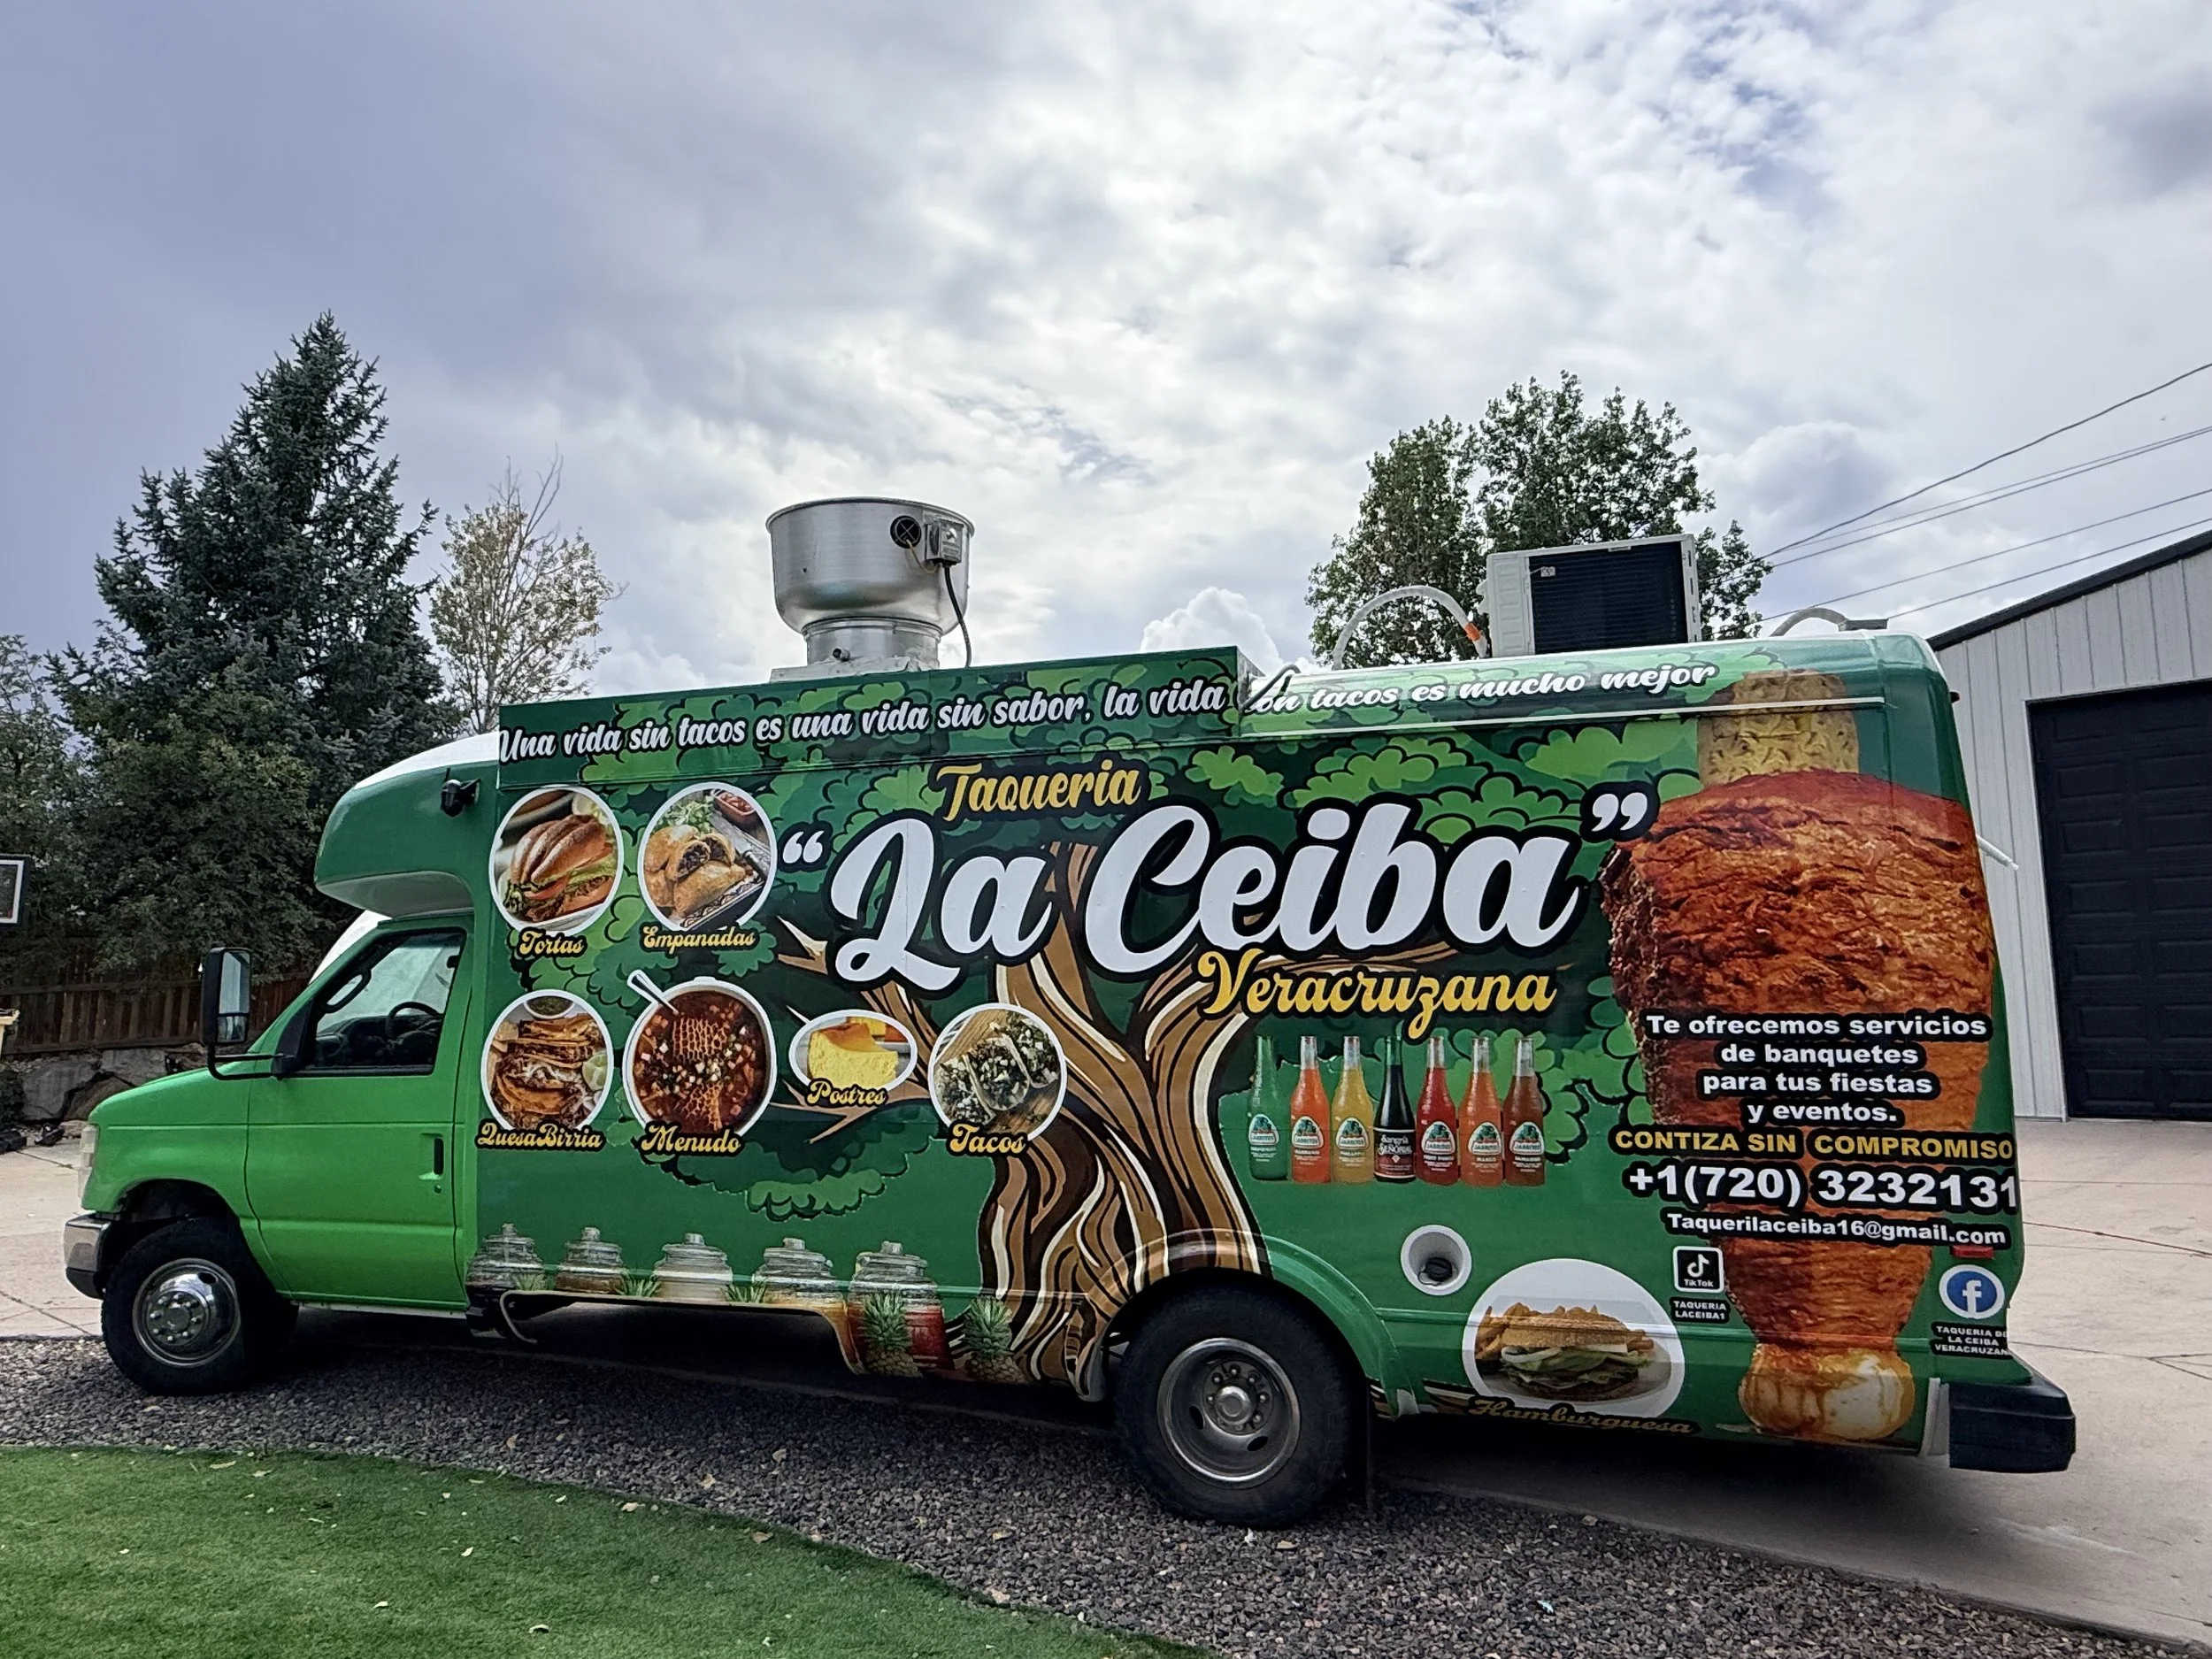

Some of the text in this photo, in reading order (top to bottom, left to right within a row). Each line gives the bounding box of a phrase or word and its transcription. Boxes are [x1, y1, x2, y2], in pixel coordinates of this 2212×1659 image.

[499, 664, 1716, 762] Una vida sin tacos es una vida sin sabor, la vida on tacos es mucho mejor
[936, 759, 1143, 822] Taqueria
[519, 928, 585, 955] Tortas
[642, 926, 757, 954] Empanadas
[1197, 949, 1558, 1039] Veracruzana
[1646, 1015, 1987, 1035] Te ofrecemos servicios
[1720, 1044, 1919, 1068] de banquetes
[806, 1079, 887, 1105] Postres
[1703, 1071, 1933, 1095] para tus fiestas
[1747, 1101, 1898, 1124] y eventos.
[477, 1122, 603, 1148] QuesaBirria
[641, 1125, 741, 1153] Menudo
[949, 1123, 1027, 1154] Tacos
[1615, 1130, 2014, 1160] CONTIZA SIN COMPROMISO
[1629, 1164, 2016, 1209] +1(720) 3232131
[1666, 1212, 2007, 1245] Taquerilaceiba16@gmail.com
[1683, 1279, 1714, 1287] TikTok
[1673, 1300, 1727, 1310] TAQUERIA
[1935, 1325, 1993, 1337] TAQUERIA
[1947, 1334, 2000, 1347] LA CEIBA
[1468, 1399, 1694, 1433] Hamburguesa
